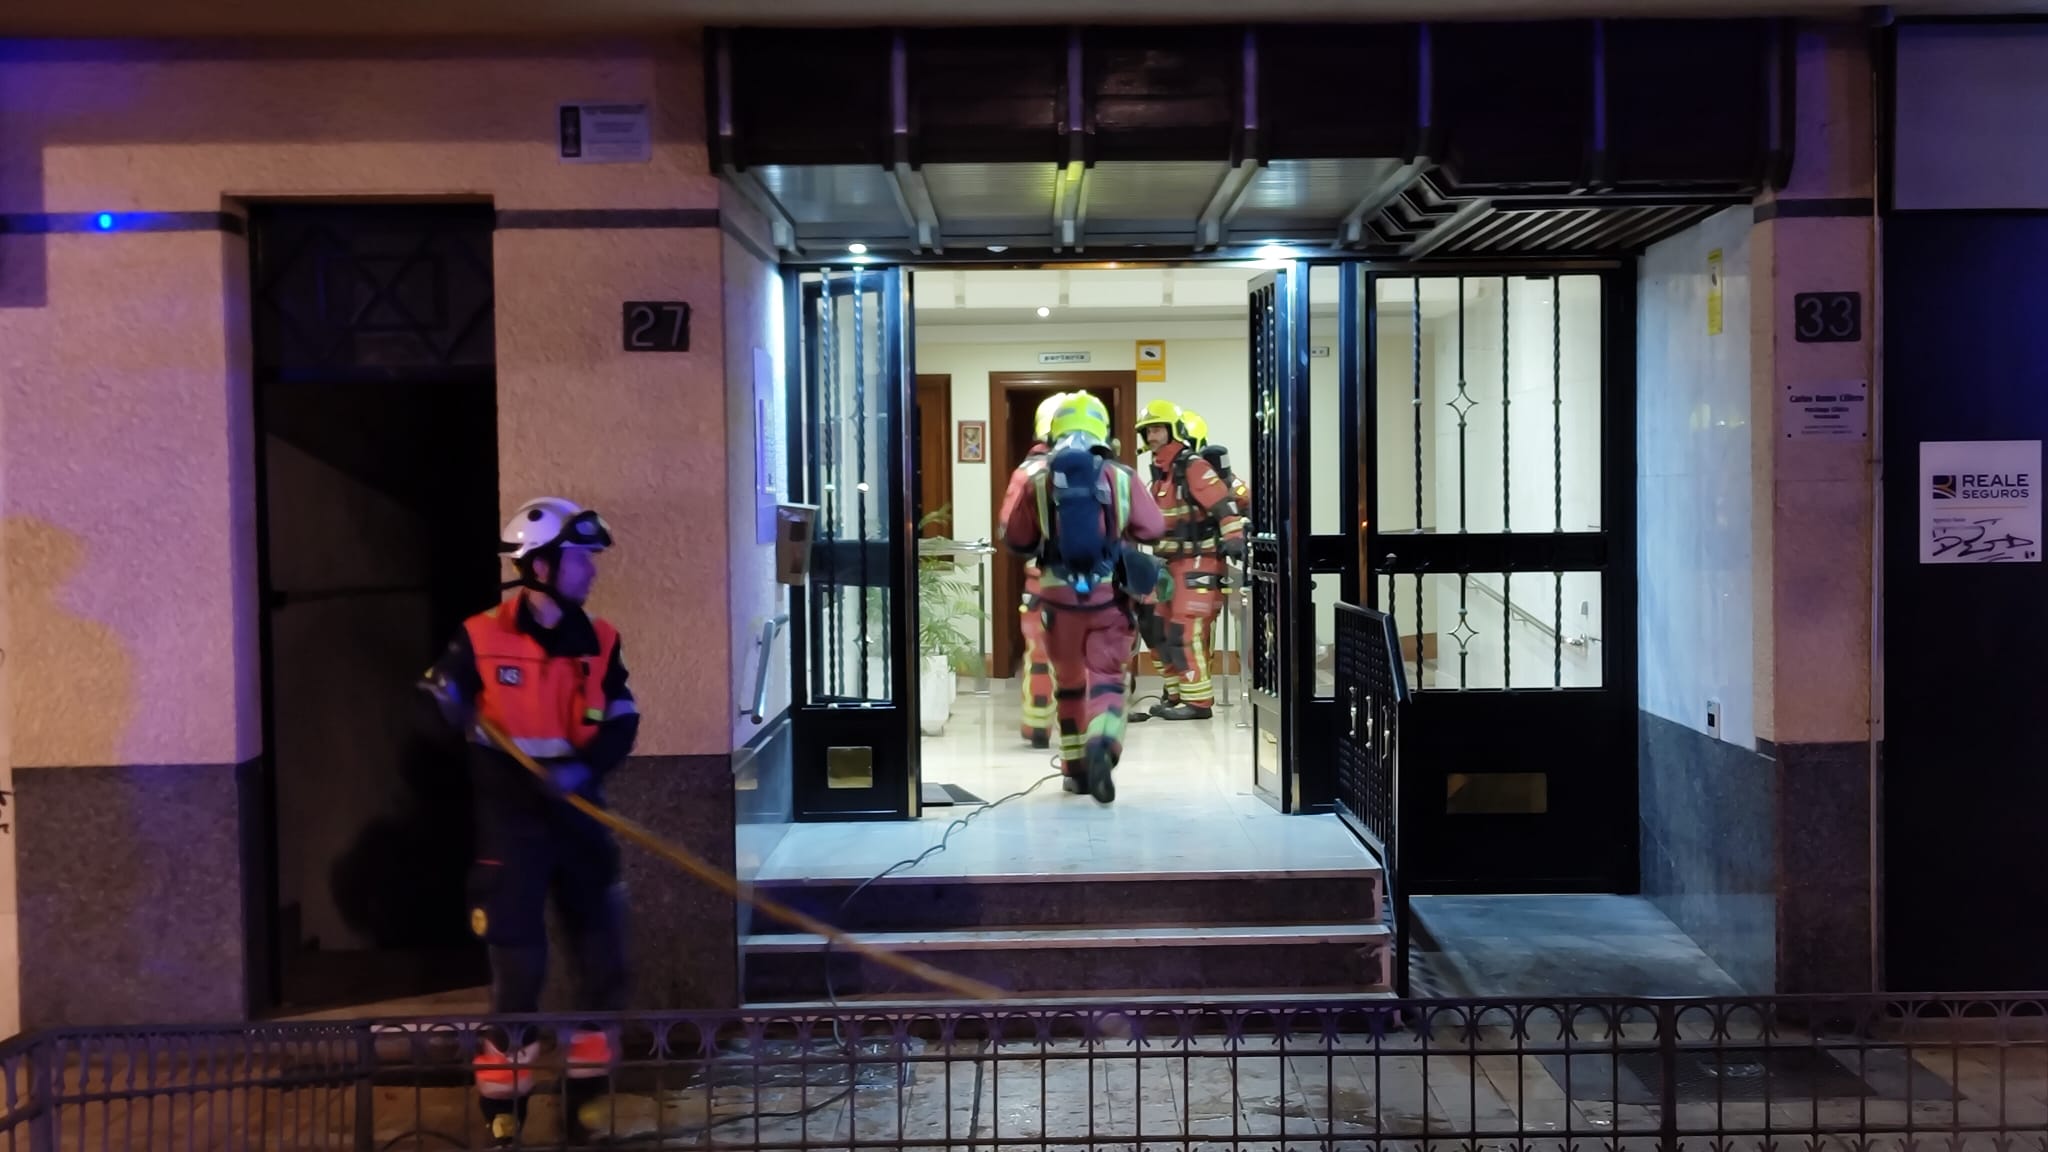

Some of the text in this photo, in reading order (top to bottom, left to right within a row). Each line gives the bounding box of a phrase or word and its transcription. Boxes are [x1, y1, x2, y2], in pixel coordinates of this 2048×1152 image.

[630, 305, 685, 347] 27
[1799, 296, 1855, 338] 33
[1962, 474, 2030, 487] REALE
[1962, 489, 2029, 499] SEGUROS
